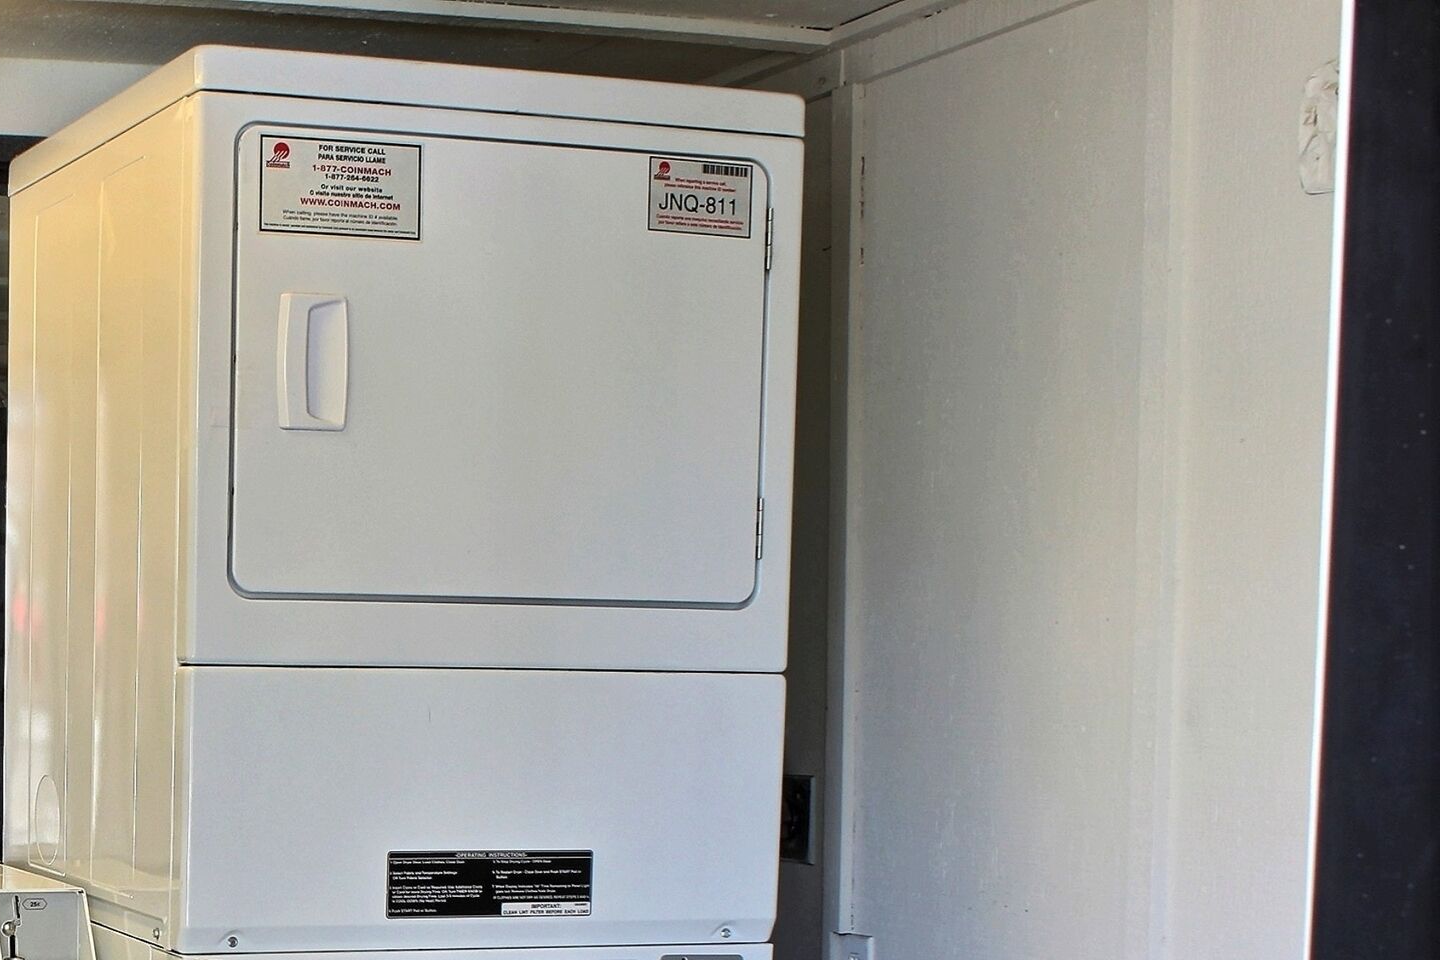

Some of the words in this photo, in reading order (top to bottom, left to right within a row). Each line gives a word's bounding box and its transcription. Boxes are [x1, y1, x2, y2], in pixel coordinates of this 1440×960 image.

[318, 144, 333, 152] FOR
[335, 145, 365, 154] SERVICE
[318, 153, 334, 161] PARA
[336, 154, 364, 162] SERVICIO
[365, 156, 386, 164] LLAME
[313, 164, 391, 176] 1-877-COINMACH
[358, 186, 382, 194] website
[300, 197, 401, 211] WWW.COINMACH.COM
[658, 192, 736, 215] JNQ-811
